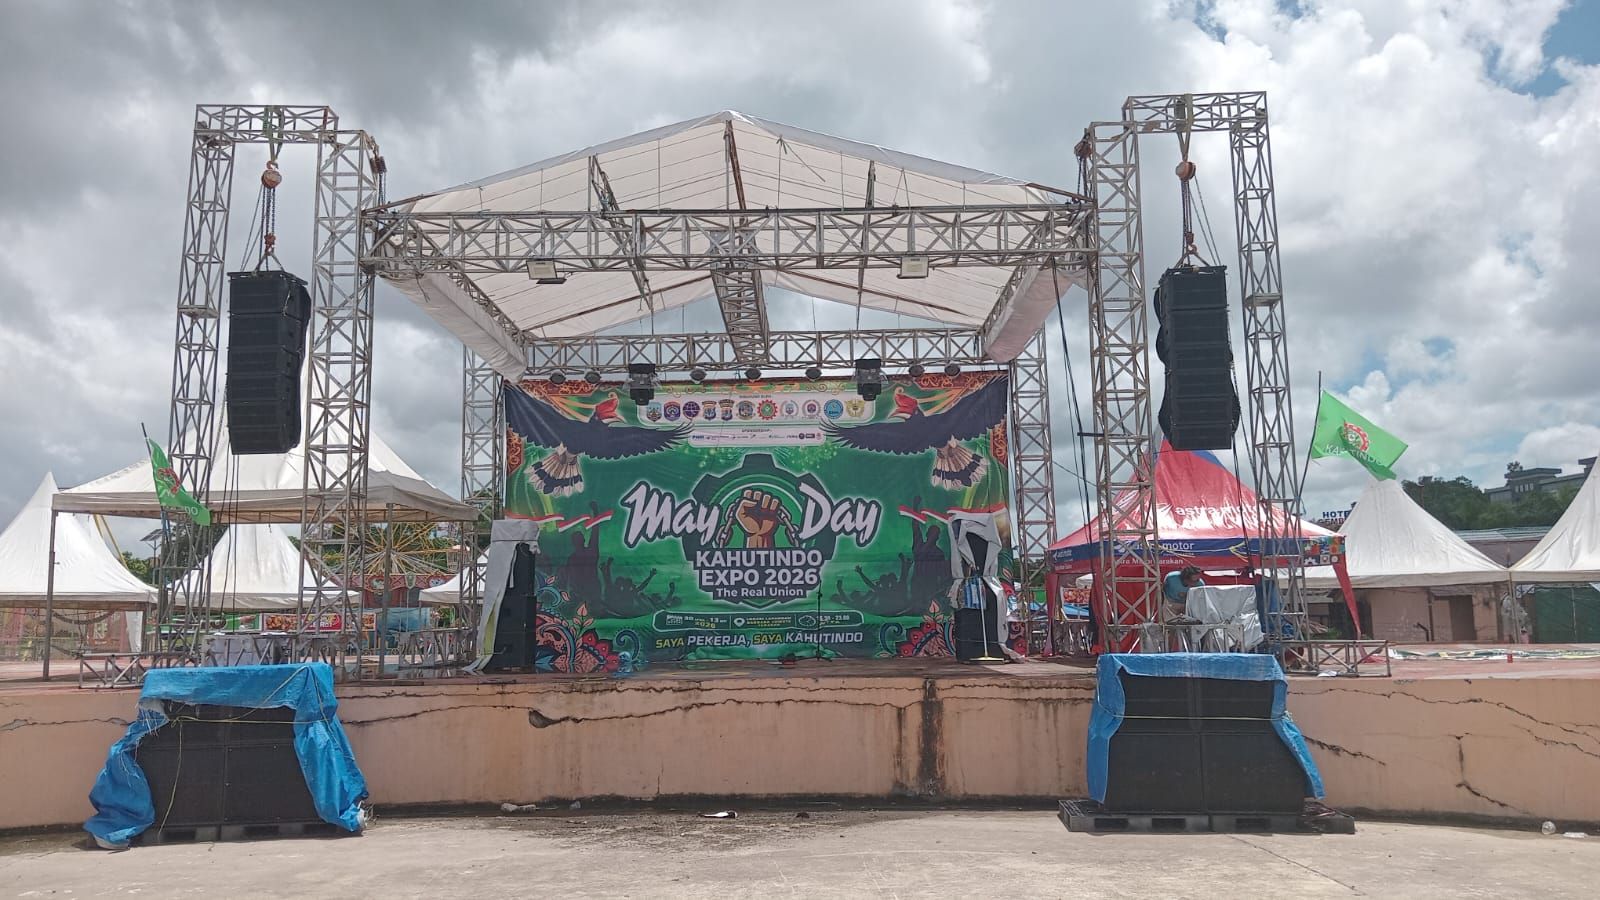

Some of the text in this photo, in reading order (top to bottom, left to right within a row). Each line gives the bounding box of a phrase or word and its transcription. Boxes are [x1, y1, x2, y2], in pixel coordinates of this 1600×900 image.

[624, 482, 879, 545] May Day
[1162, 542, 1195, 550] motor
[696, 550, 822, 568] KAHUTINDO
[701, 568, 818, 586] EXPO 2026
[716, 587, 804, 597] The Real Union
[655, 631, 864, 649] SAYA PEKERJA, SAYA KAHUTINDO
